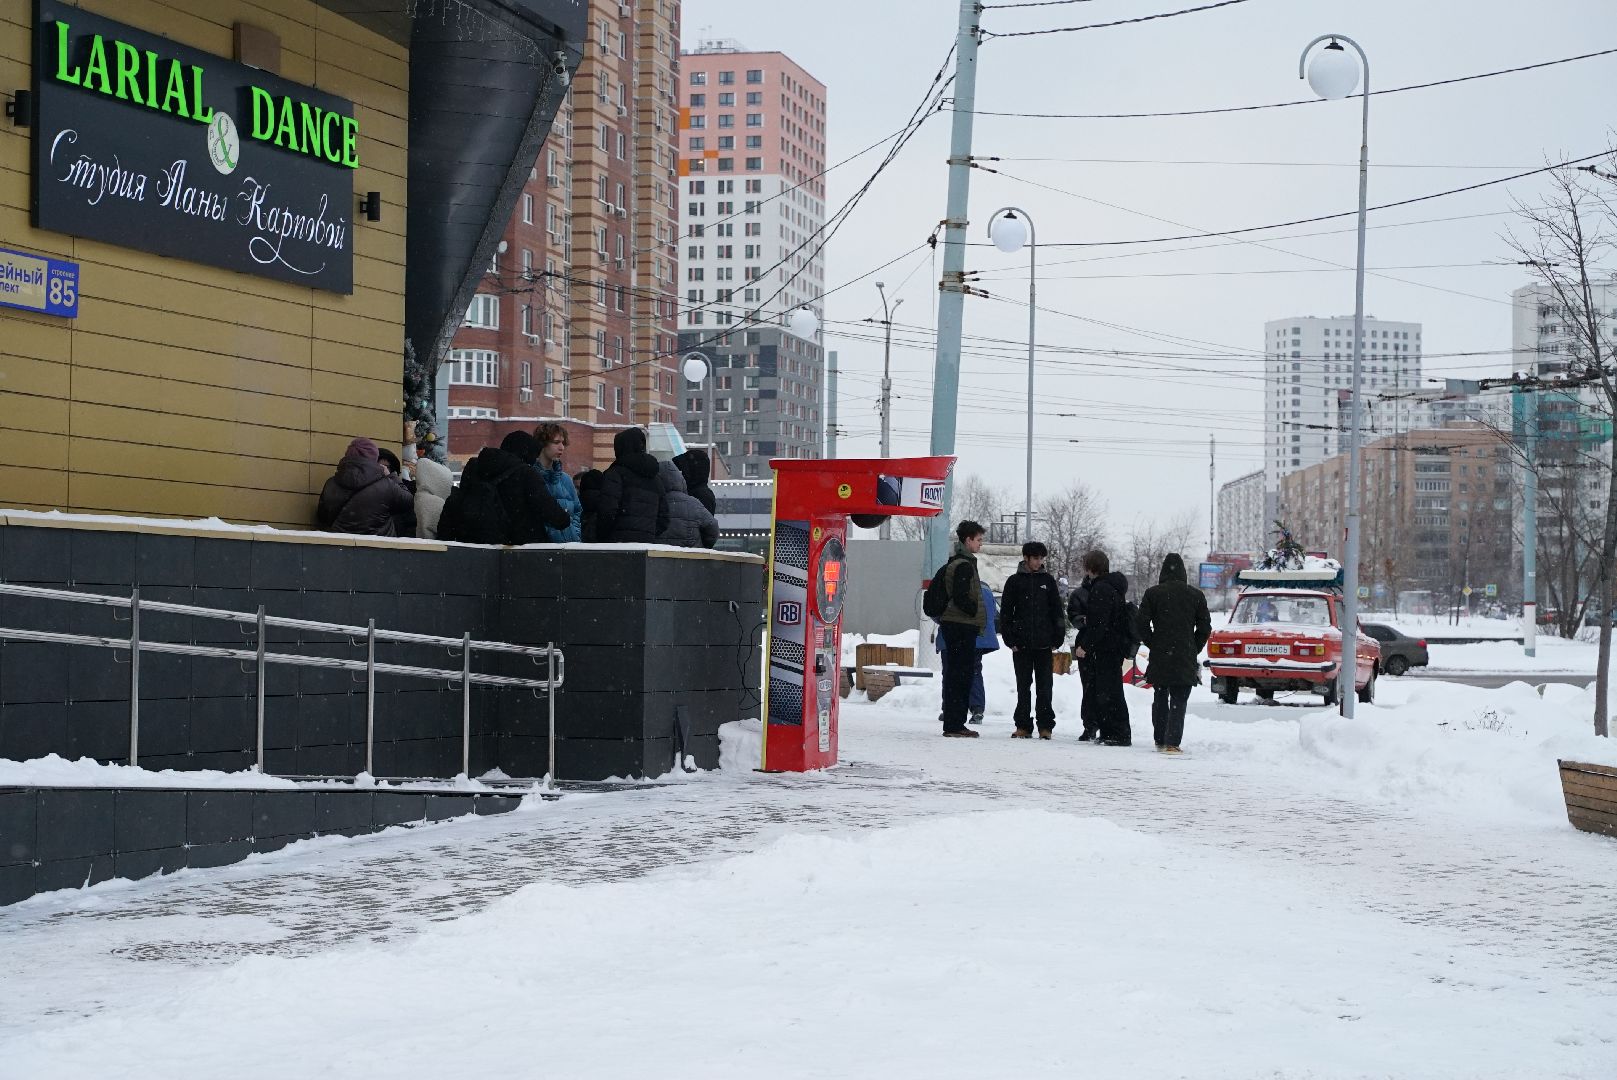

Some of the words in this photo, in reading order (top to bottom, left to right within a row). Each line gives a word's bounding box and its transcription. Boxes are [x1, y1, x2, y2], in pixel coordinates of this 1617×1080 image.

[55, 21, 213, 125] LARIAL
[251, 85, 360, 169] DANCE
[50, 129, 147, 206] Студия
[157, 159, 228, 222] Ланы
[237, 176, 346, 274] Карповой
[49, 277, 75, 307] 85
[780, 604, 798, 621] RB
[1247, 645, 1288, 654] УЛЫБНИСЬ
